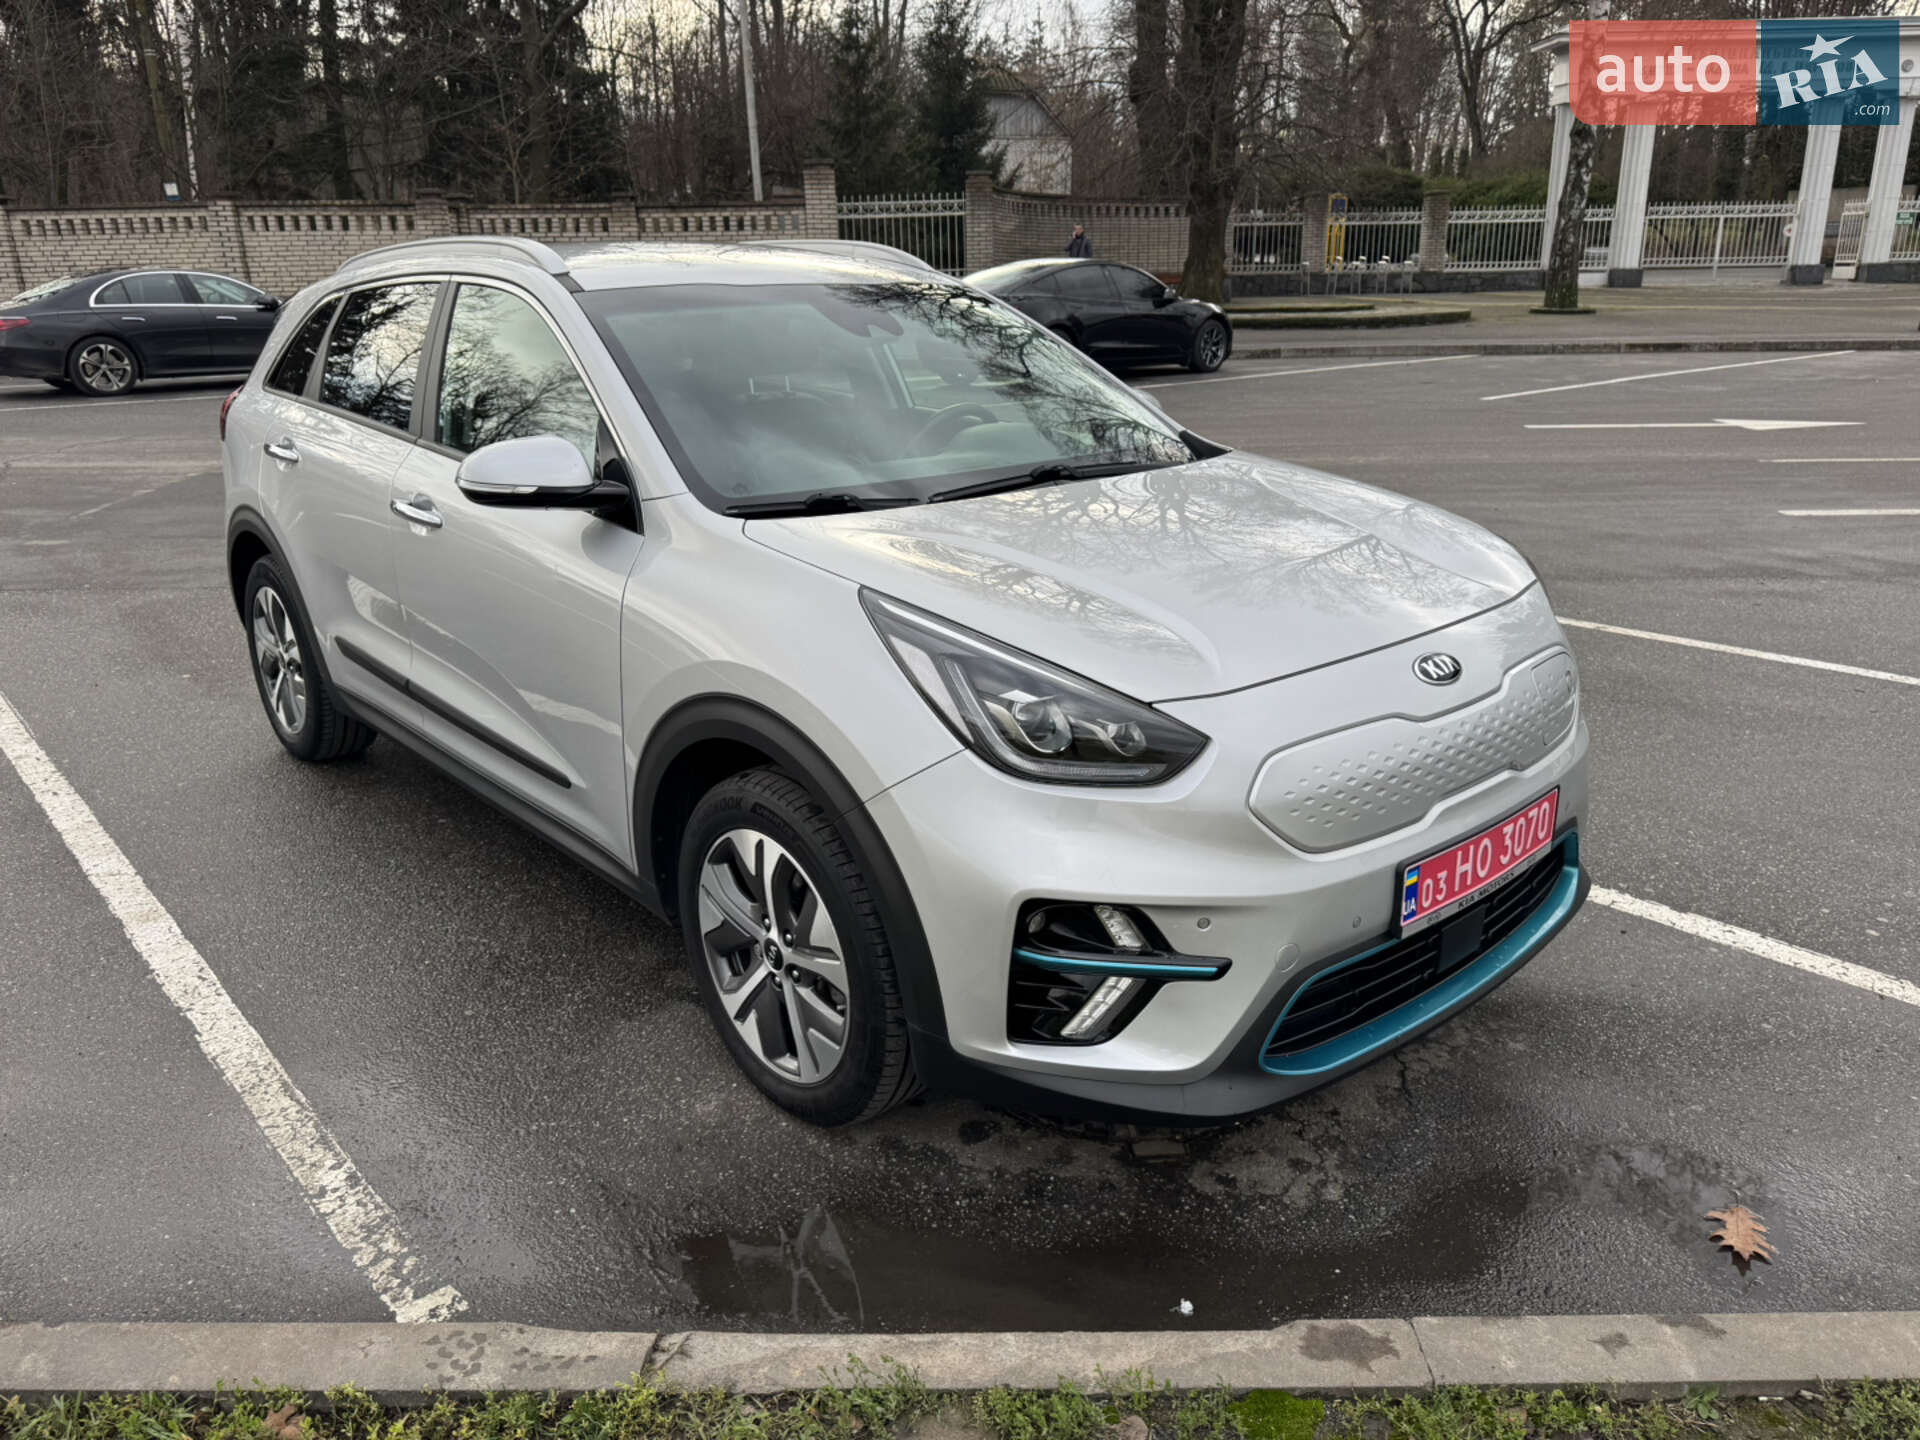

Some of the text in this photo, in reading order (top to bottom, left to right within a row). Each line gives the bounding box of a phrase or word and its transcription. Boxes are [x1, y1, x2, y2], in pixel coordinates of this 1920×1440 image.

[1422, 801, 1550, 908] 03 HO 3070
[1401, 897, 1417, 915] UA
